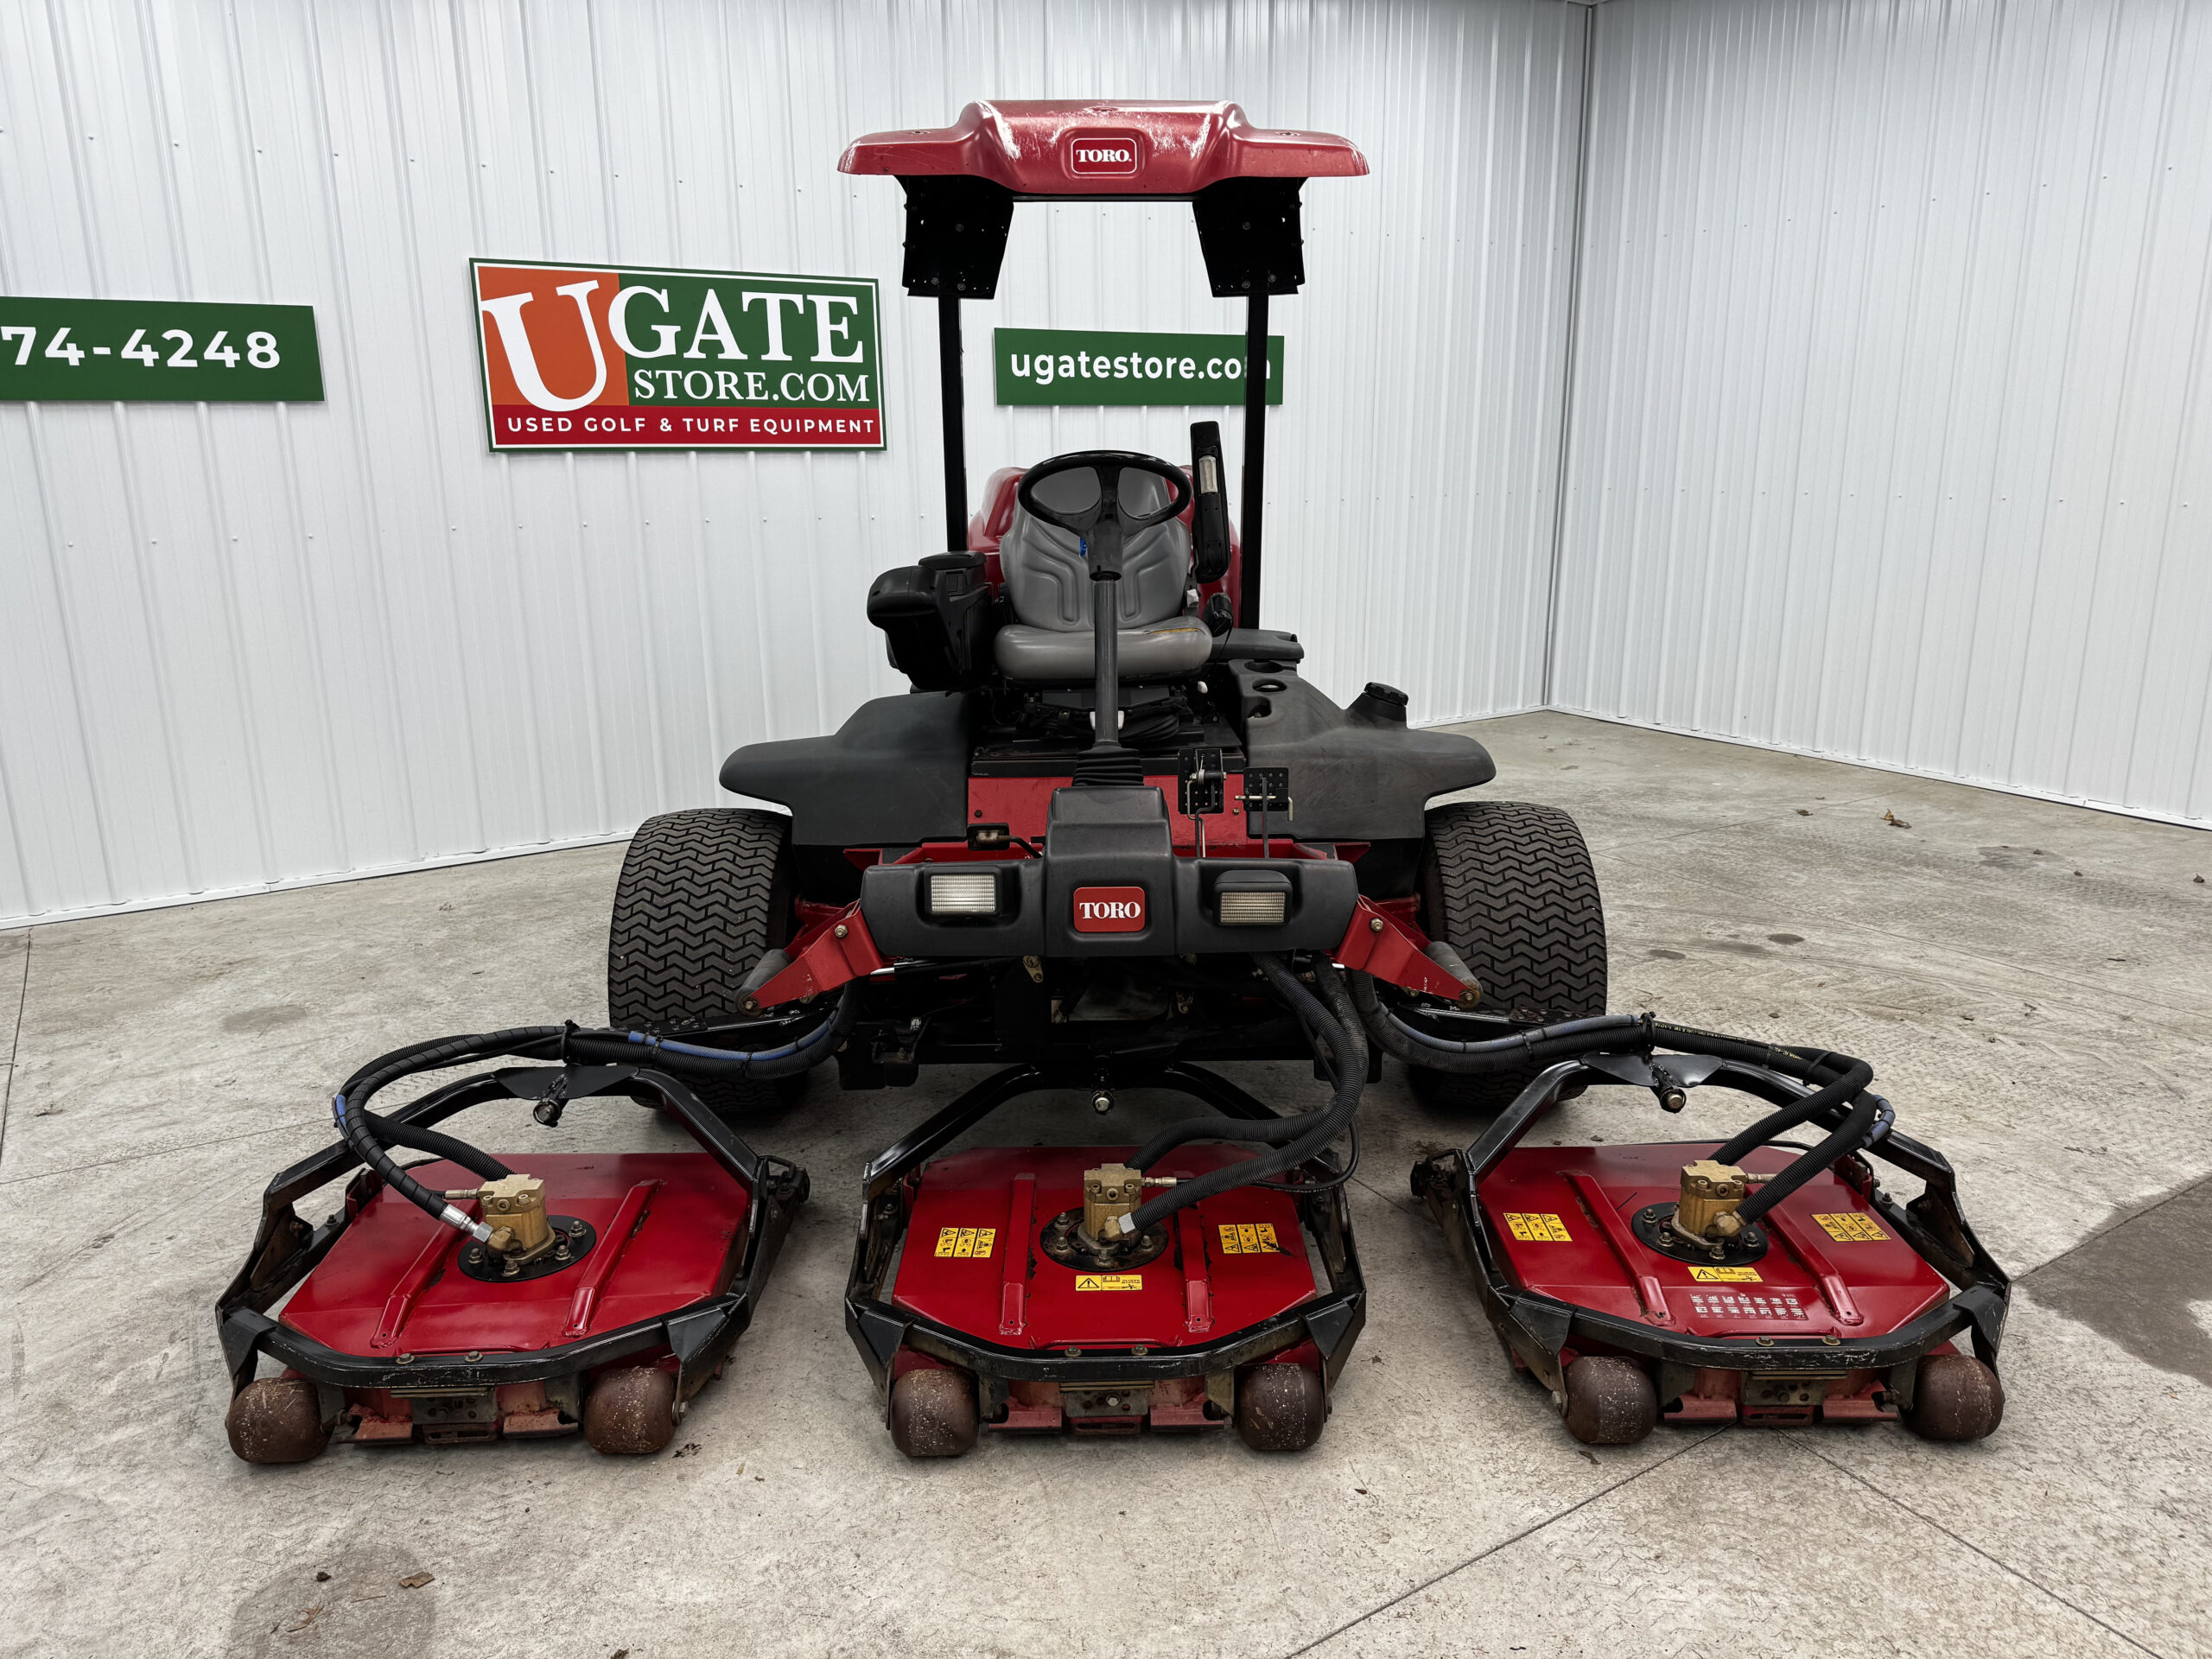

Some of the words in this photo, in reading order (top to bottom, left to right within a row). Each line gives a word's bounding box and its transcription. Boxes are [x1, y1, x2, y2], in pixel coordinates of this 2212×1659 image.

[1076, 149, 1131, 162] TORO
[0, 326, 281, 369] 74-4248
[633, 369, 871, 402] STORE.COM
[507, 416, 573, 432] USED
[584, 416, 647, 433] GOLF
[659, 418, 673, 432] &
[683, 417, 740, 433] TURF
[750, 418, 875, 435] EQUIPMENT
[1079, 901, 1141, 919] TORO
